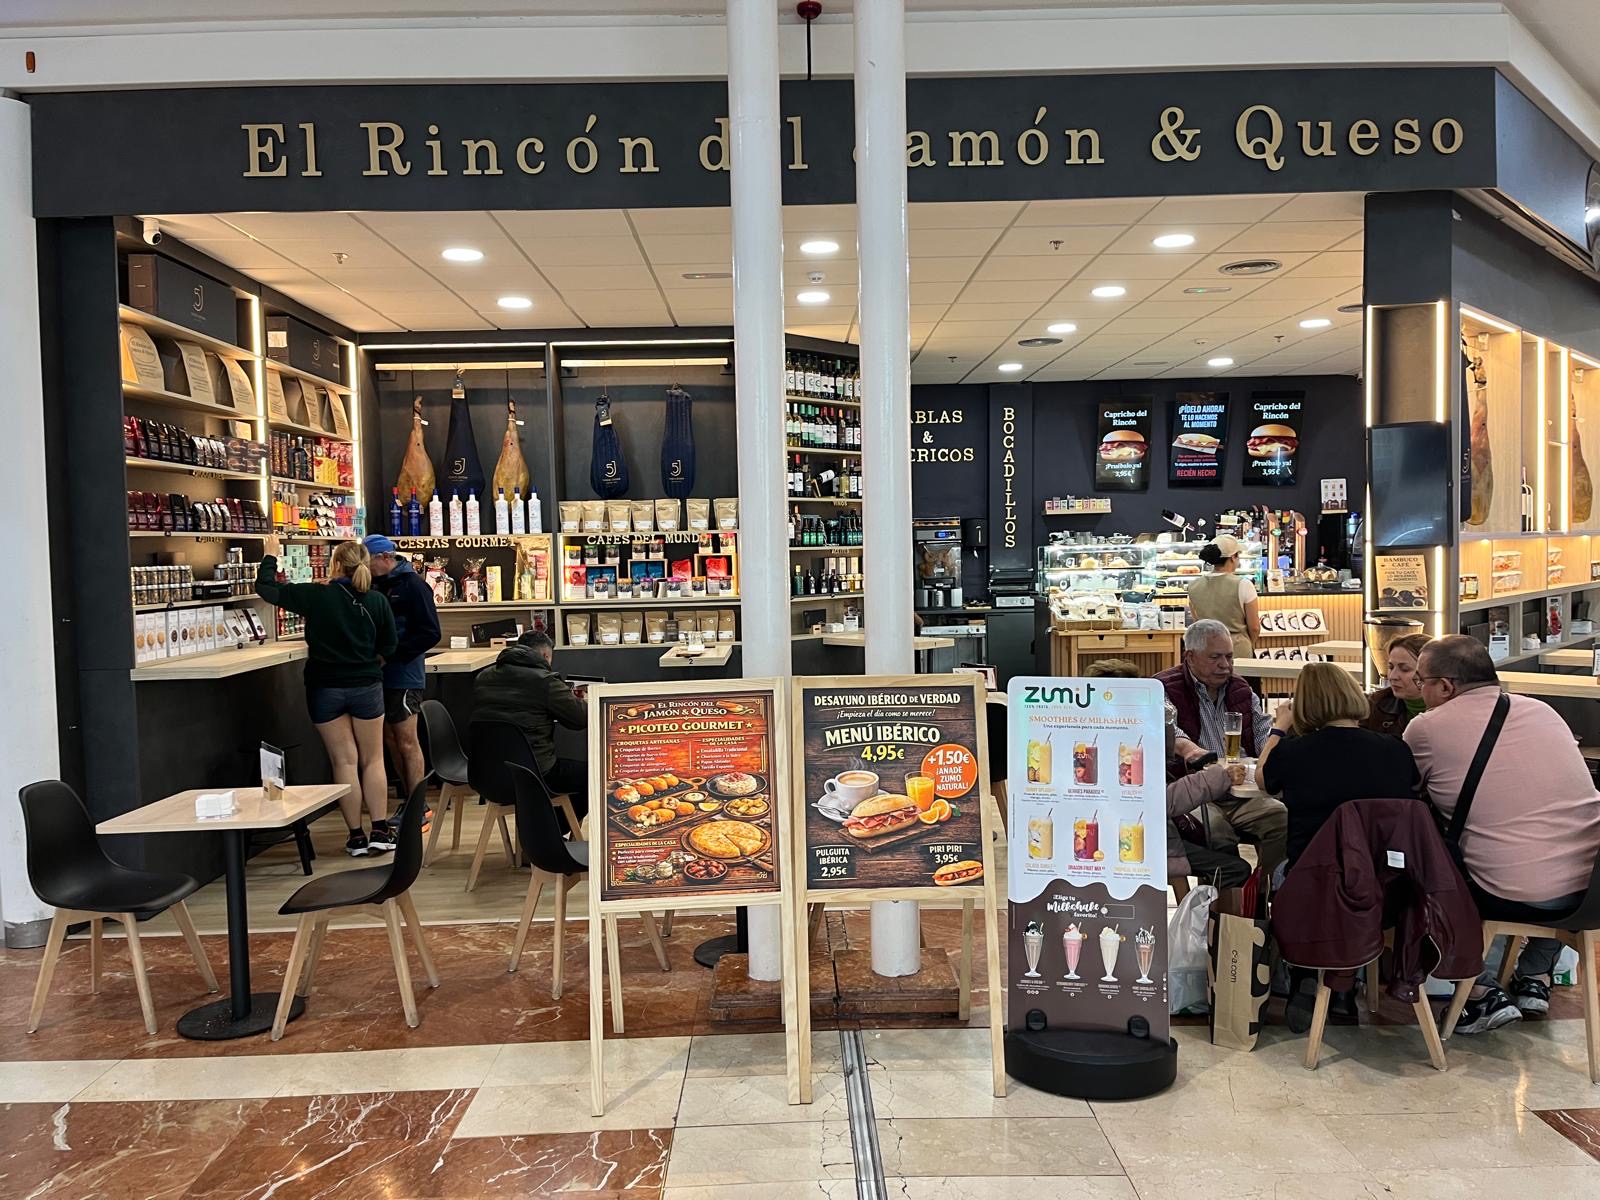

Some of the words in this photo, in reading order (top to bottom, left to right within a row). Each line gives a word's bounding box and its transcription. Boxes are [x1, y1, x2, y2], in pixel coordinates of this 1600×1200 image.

[242, 123, 322, 178] El
[361, 113, 660, 178] Rincón
[699, 116, 808, 172] dl
[853, 107, 1104, 168] amón
[1151, 106, 1202, 162] &
[1236, 104, 1464, 171] Queso
[1202, 404, 1225, 413] AHORA!
[1254, 402, 1288, 412] Capricho
[1289, 402, 1301, 410] del
[911, 410, 963, 424] BLAS
[1104, 411, 1136, 420] Capricho
[1136, 410, 1147, 418] del
[1262, 412, 1289, 420] Rincón
[922, 430, 934, 444] &
[1003, 407, 1017, 548] BOCADILLOS
[398, 538, 450, 549] CESTAS
[455, 537, 517, 548] GOURMET
[814, 694, 866, 706] DESAYUNO
[867, 692, 908, 705] IBÉRICO
[920, 693, 961, 705] VERDAD
[837, 709, 866, 720] ¡Empieza
[874, 709, 884, 717] día
[910, 709, 936, 717] merece!
[1029, 715, 1078, 723] SMOOTHIES
[628, 723, 679, 734] PICOTEO
[681, 721, 744, 731] GOURMET
[825, 724, 873, 747] MENÚ
[877, 722, 941, 743] IBÉRICO
[861, 745, 905, 763] 4,95€
[940, 774, 962, 783] ZUMO
[936, 782, 969, 791] NATURAL!
[816, 847, 850, 858] PULGUITA
[929, 845, 945, 854] PIRI
[946, 844, 963, 853] PIRI
[819, 855, 848, 865] IBÉRICA
[935, 854, 959, 864] 3,95€
[821, 866, 847, 878] 2,95€
[1046, 901, 1100, 913] Milkshake
